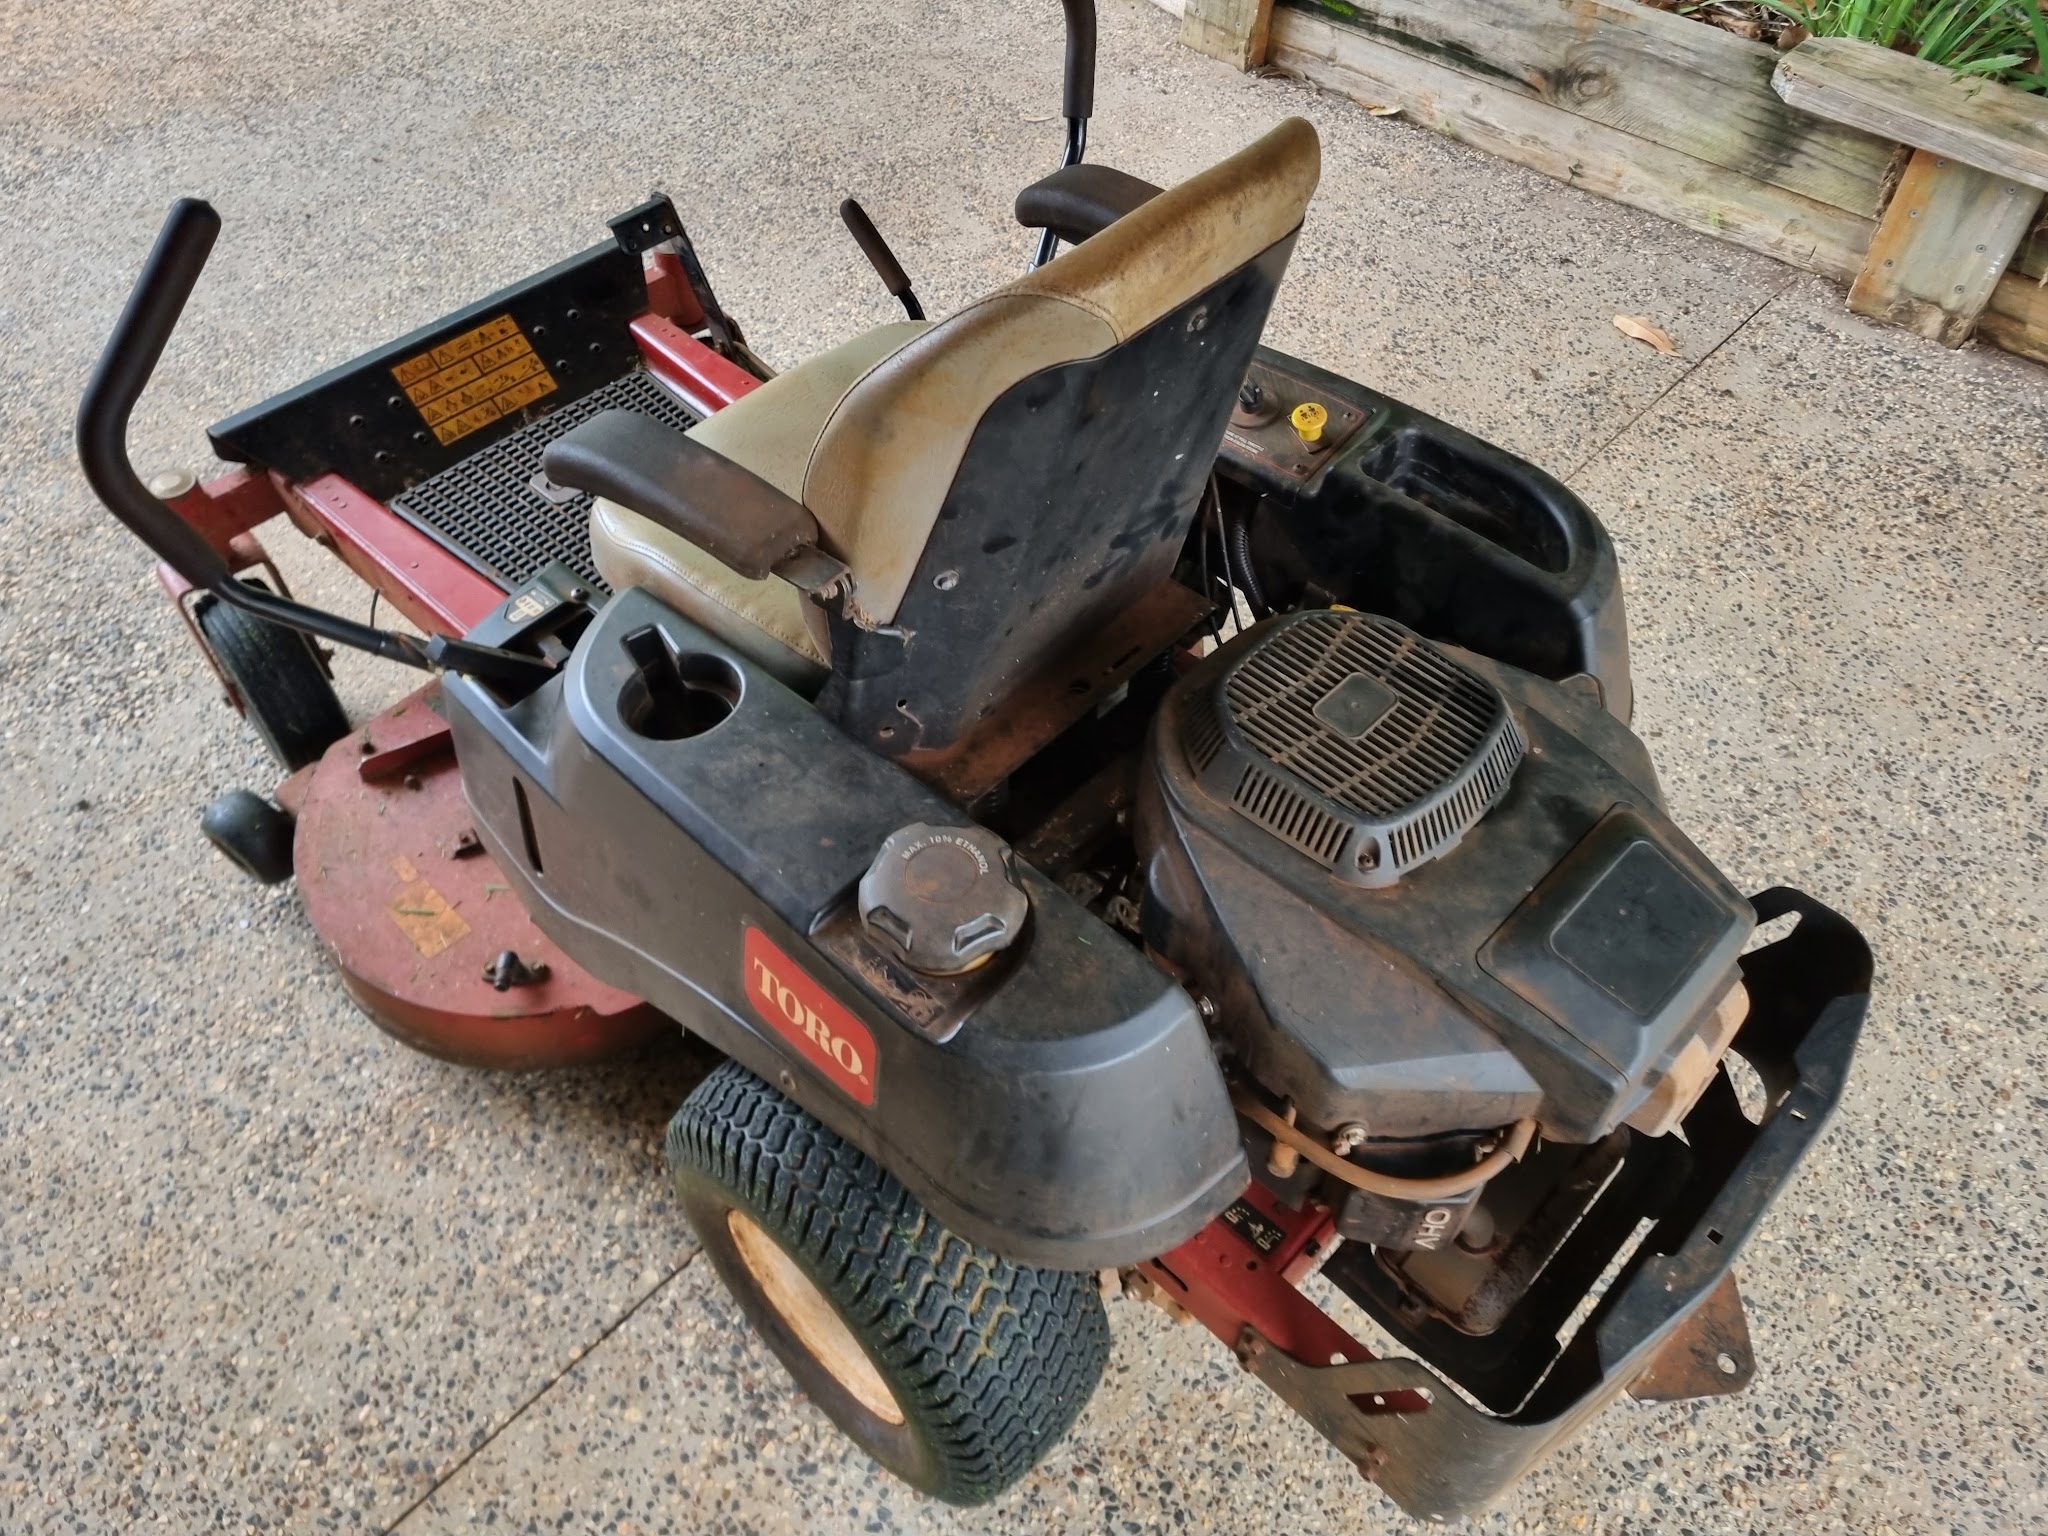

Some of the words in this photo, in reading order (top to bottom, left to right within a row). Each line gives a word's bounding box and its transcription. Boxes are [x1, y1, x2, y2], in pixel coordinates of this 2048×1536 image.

[901, 840, 927, 860] MAX.
[929, 834, 953, 844] 10%
[955, 836, 989, 875] ETHANOL
[753, 957, 863, 1075] TORO
[1415, 1209, 1451, 1250] OHV
